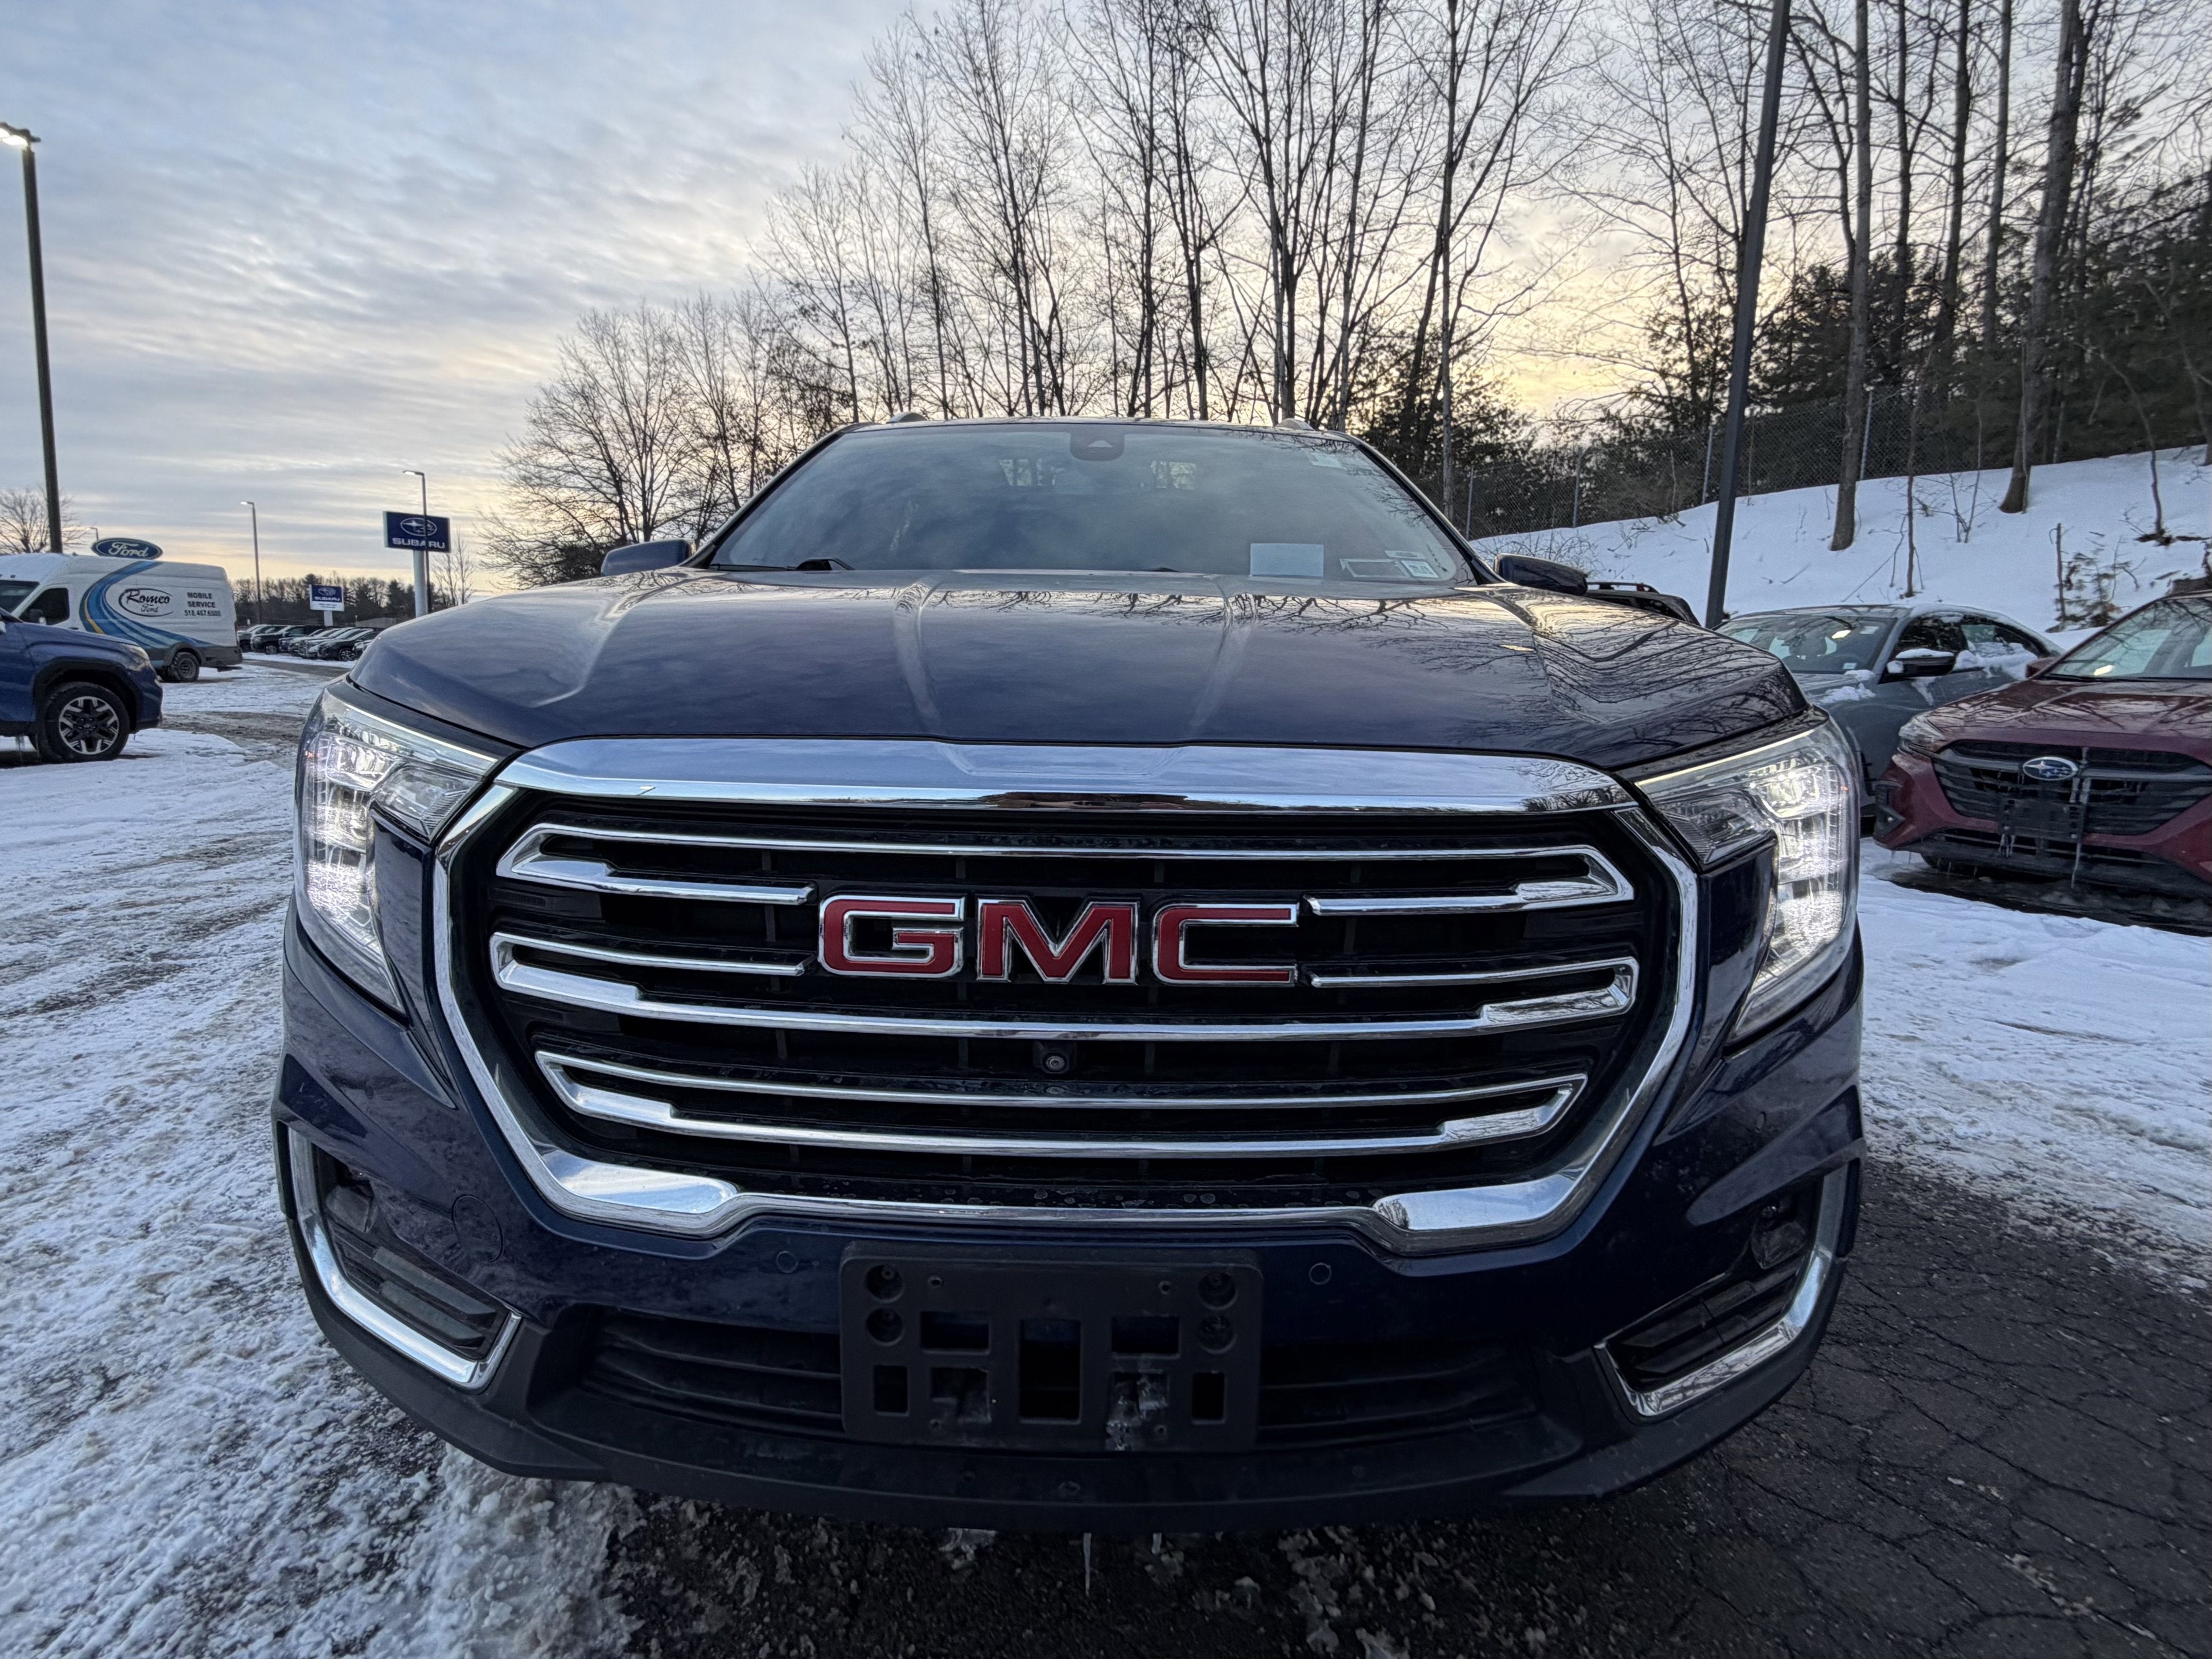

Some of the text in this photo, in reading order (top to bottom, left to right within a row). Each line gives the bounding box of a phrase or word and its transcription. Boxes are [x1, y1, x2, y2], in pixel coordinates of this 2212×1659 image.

[108, 542, 149, 557] Ford
[392, 537, 445, 549] SUBARU
[127, 589, 170, 604] Romeo
[141, 603, 158, 612] Ford
[818, 895, 1300, 986] GMC
